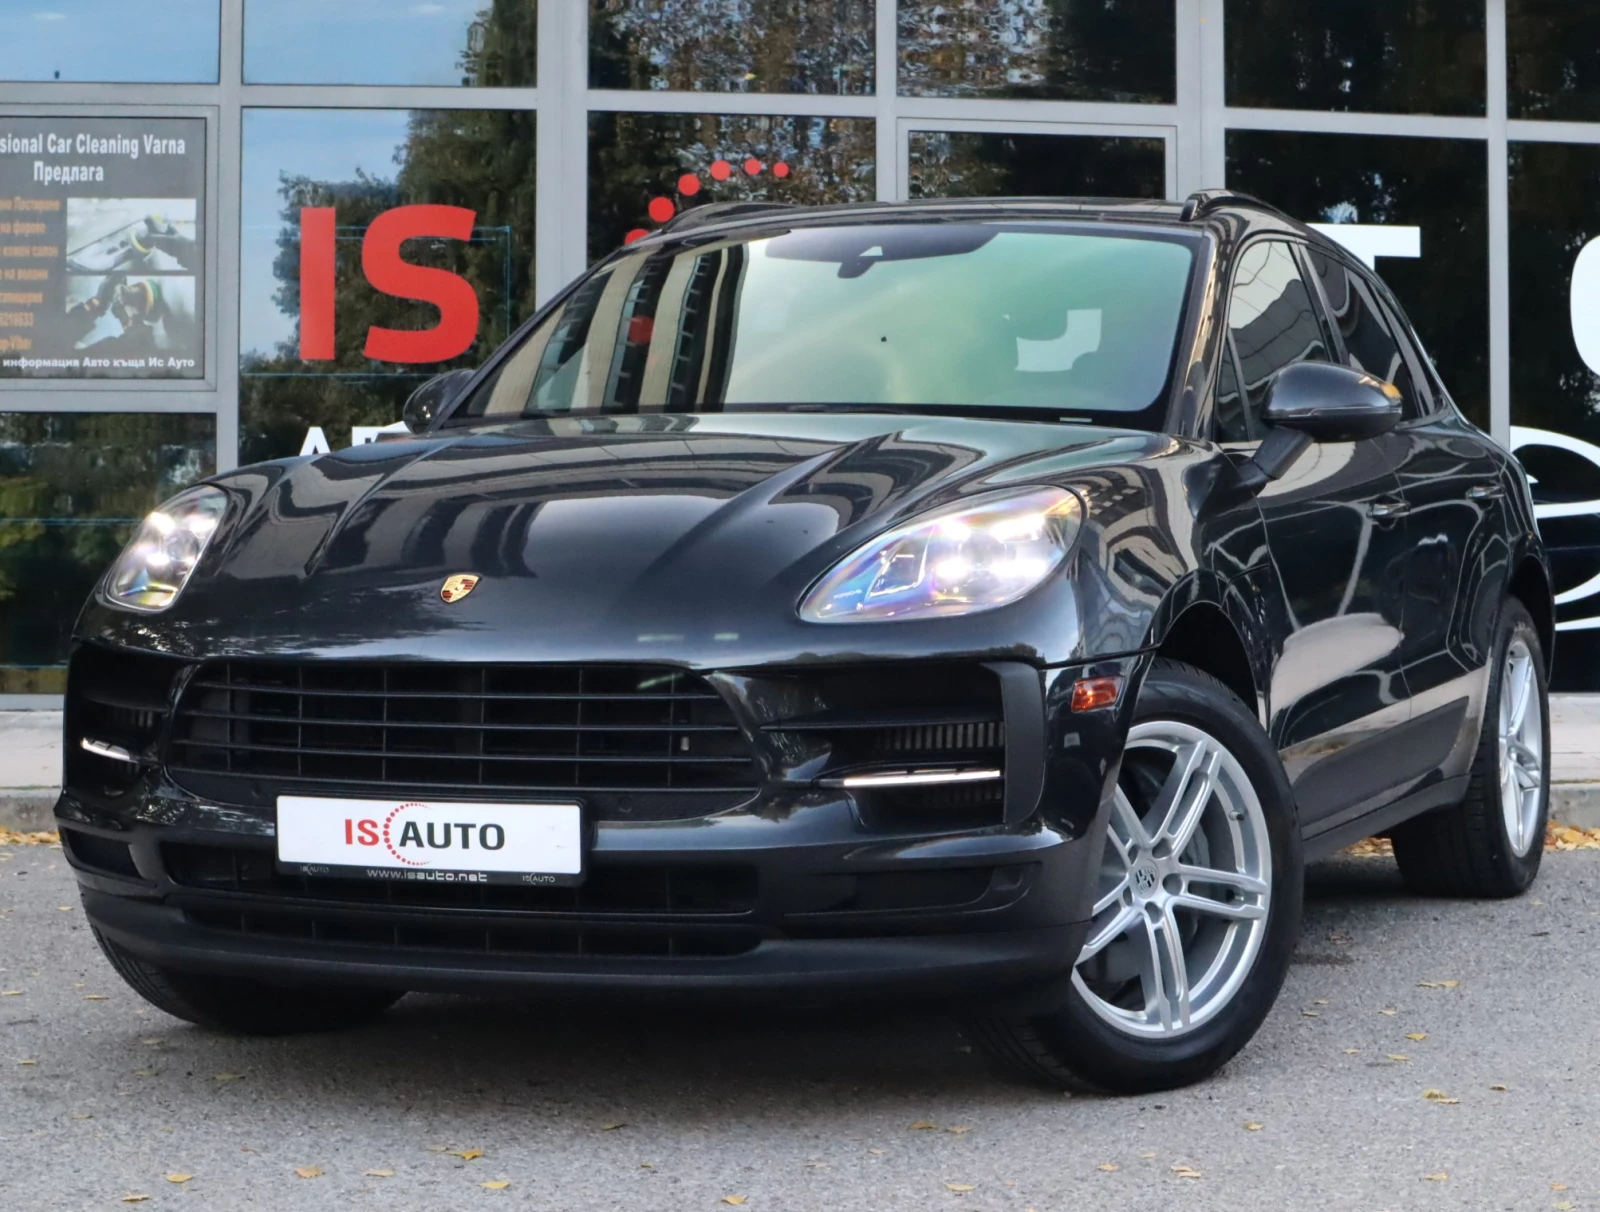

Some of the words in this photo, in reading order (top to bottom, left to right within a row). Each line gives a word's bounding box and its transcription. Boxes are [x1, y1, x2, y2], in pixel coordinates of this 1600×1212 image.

[47, 134, 73, 154] Car
[76, 134, 140, 159] Cleaning
[143, 135, 186, 155] Varna
[33, 161, 105, 185] Предлага
[300, 204, 479, 363] IS
[3, 357, 80, 370] информация
[83, 357, 110, 368] Авто
[113, 359, 145, 370] къща
[148, 357, 164, 368] Ис
[168, 358, 195, 370] Ауто
[399, 820, 505, 851] AUTO
[366, 868, 488, 884] www.isauto.net
